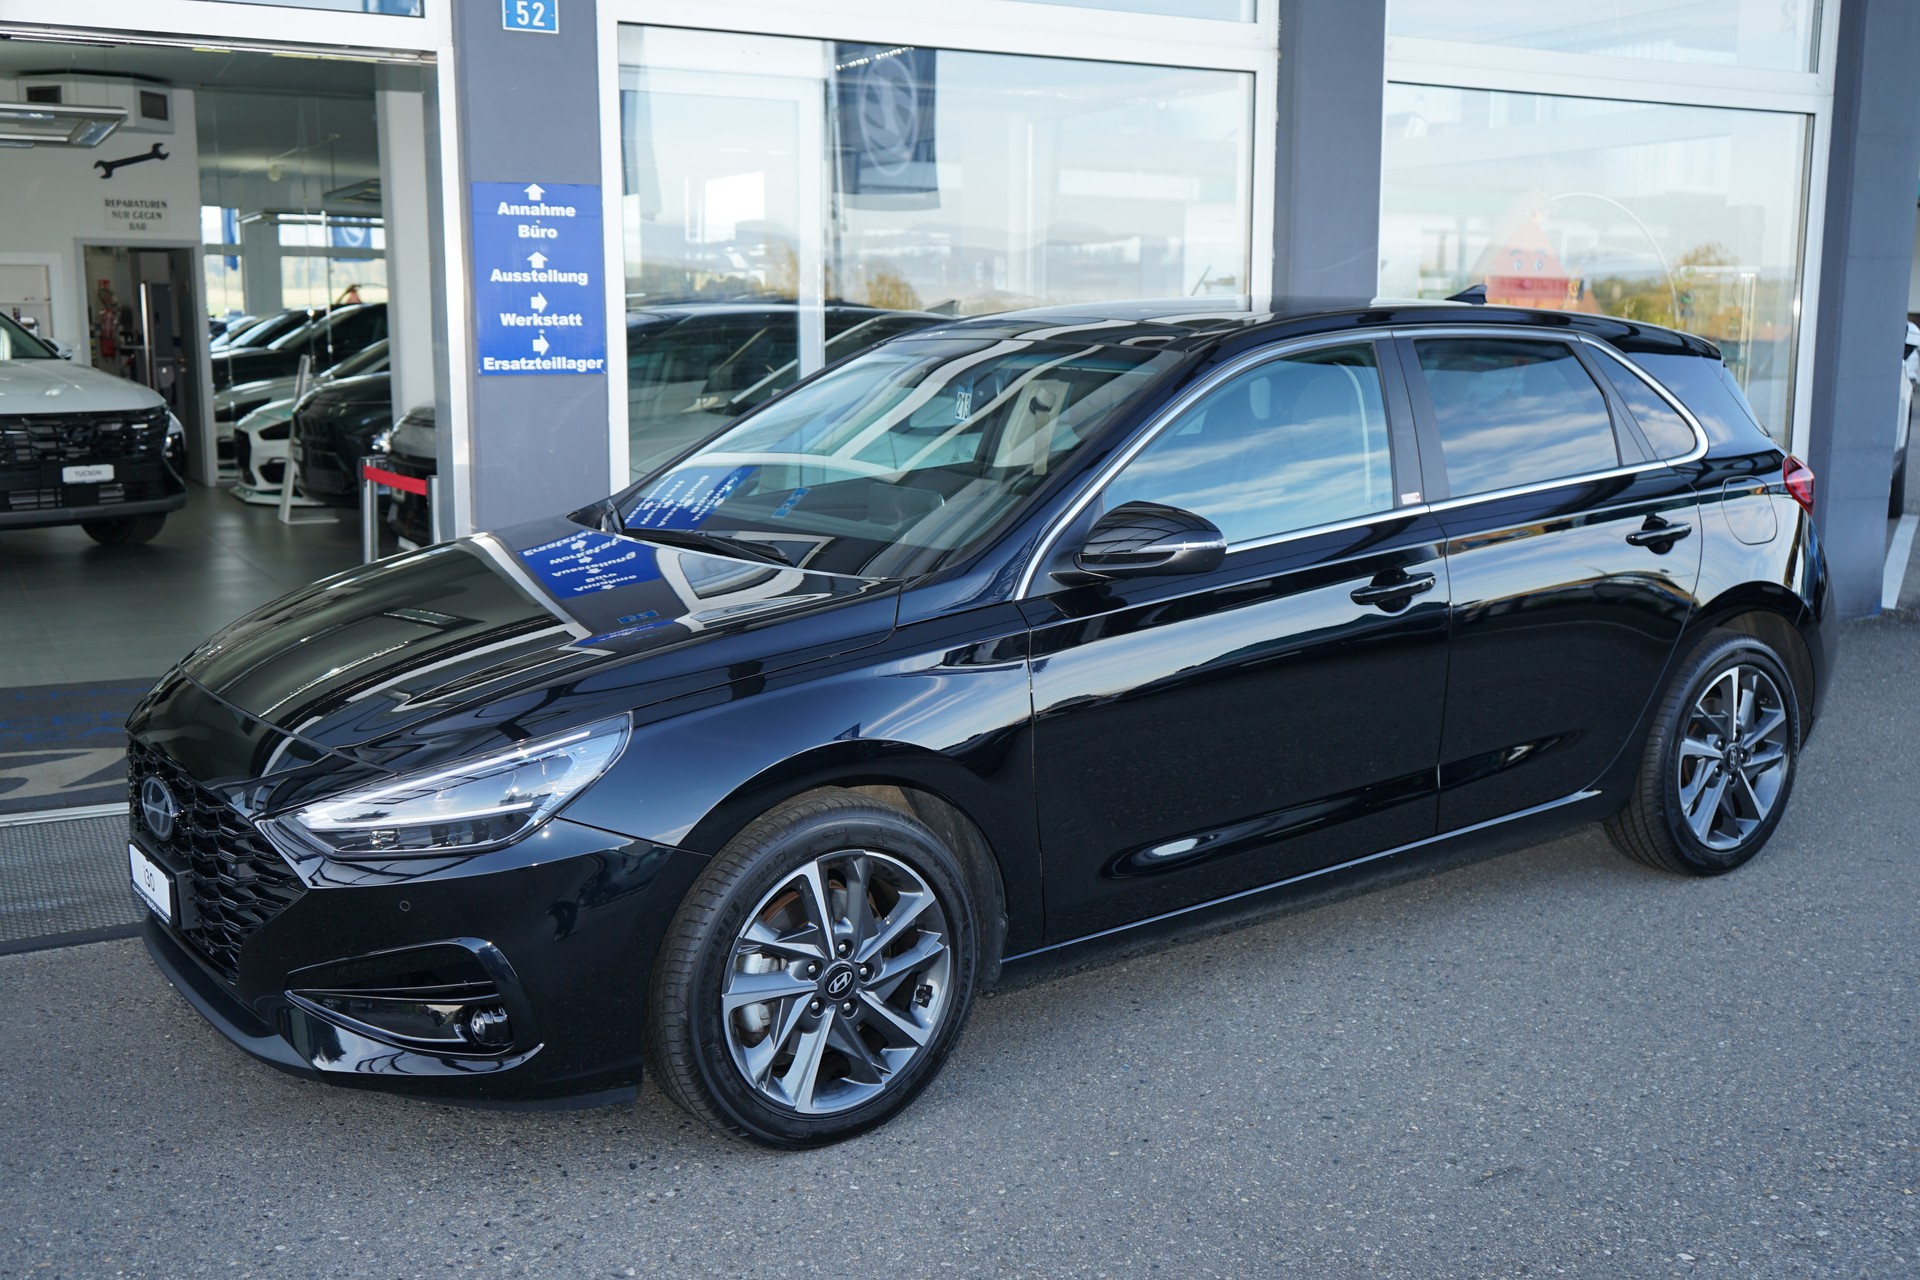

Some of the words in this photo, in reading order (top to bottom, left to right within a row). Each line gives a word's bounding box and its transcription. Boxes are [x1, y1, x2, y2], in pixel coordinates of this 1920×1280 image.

[516, 0, 545, 27] 52
[105, 199, 167, 209] REPARATUREN
[497, 202, 576, 217] Annahme
[129, 222, 147, 231] BAR
[518, 225, 558, 239] Büro
[490, 269, 589, 286] Ausstellung
[500, 313, 583, 327] Werkstatt
[483, 357, 604, 372] Ersatzteillager
